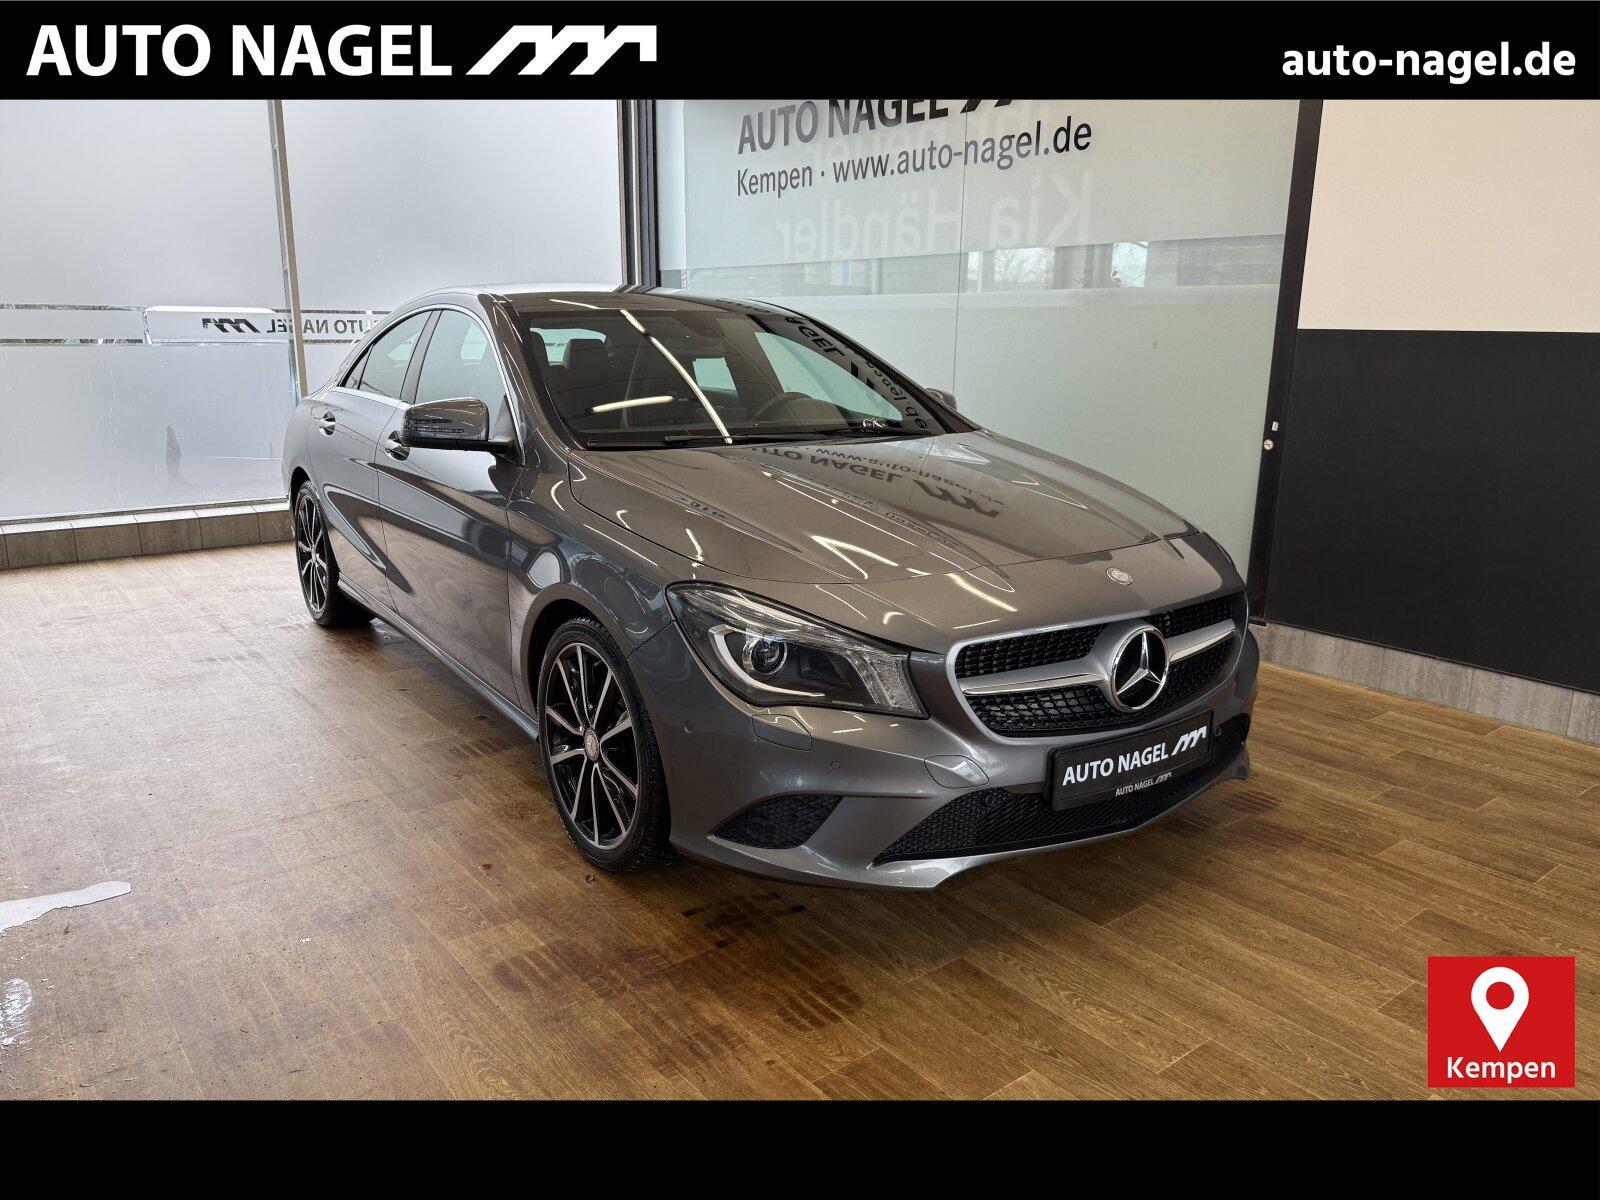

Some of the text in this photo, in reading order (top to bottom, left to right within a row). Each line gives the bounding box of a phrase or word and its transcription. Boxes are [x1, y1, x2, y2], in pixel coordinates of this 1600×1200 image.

[737, 100, 818, 155] AUTO
[737, 115, 1092, 199] Kempen www.auto-nagel.de
[1062, 742, 1169, 786] AUTO NAGEL
[1115, 778, 1155, 797] AUTO NAGEL
